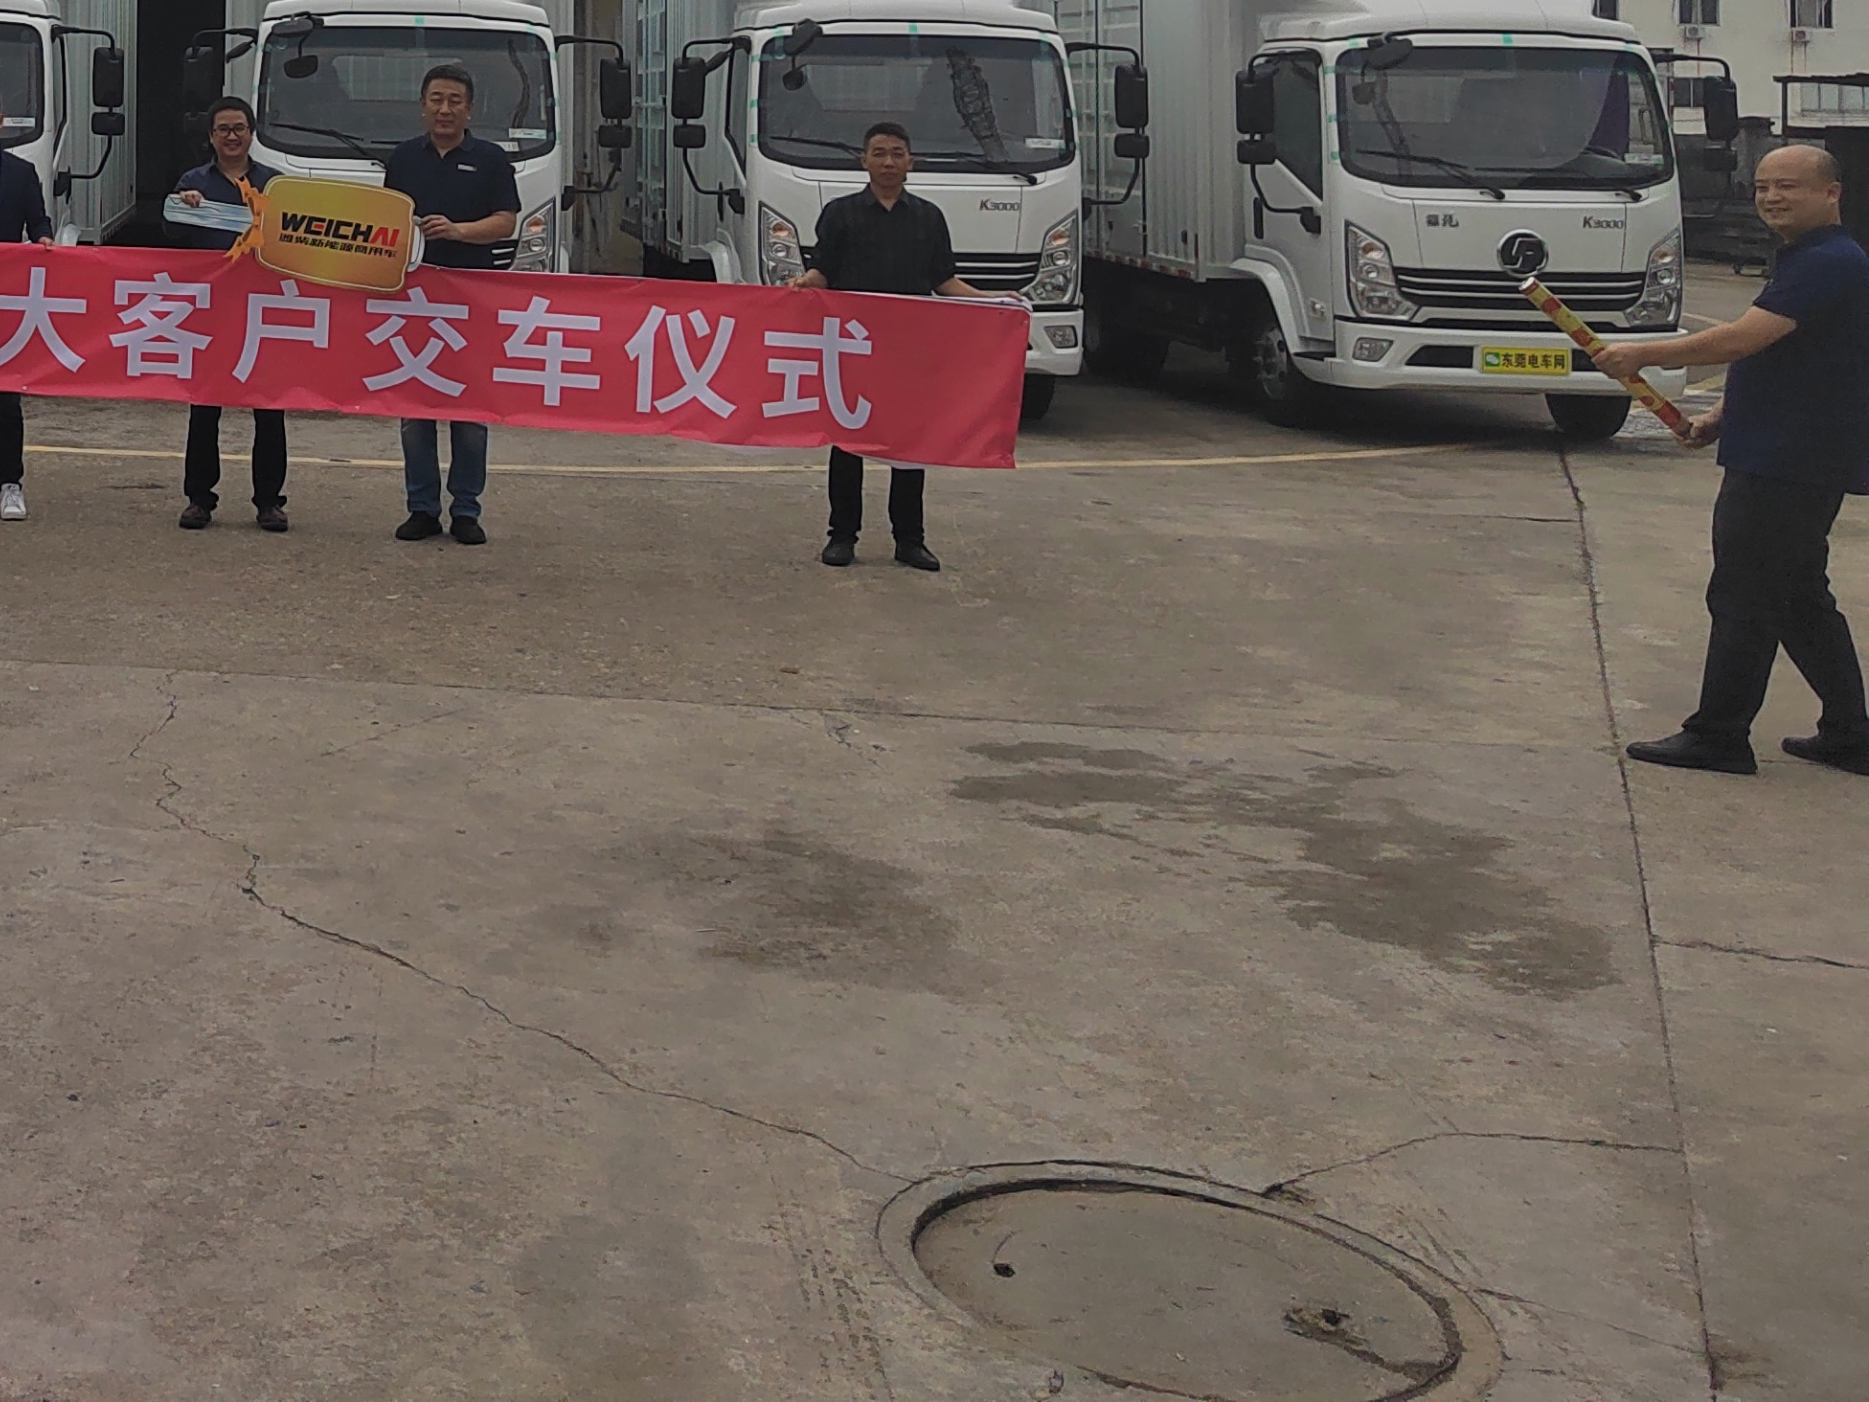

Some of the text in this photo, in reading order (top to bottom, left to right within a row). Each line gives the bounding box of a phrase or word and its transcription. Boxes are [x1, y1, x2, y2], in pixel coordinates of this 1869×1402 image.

[281, 211, 400, 247] WEICHAI
[1501, 352, 1565, 369] 东莞电车网
